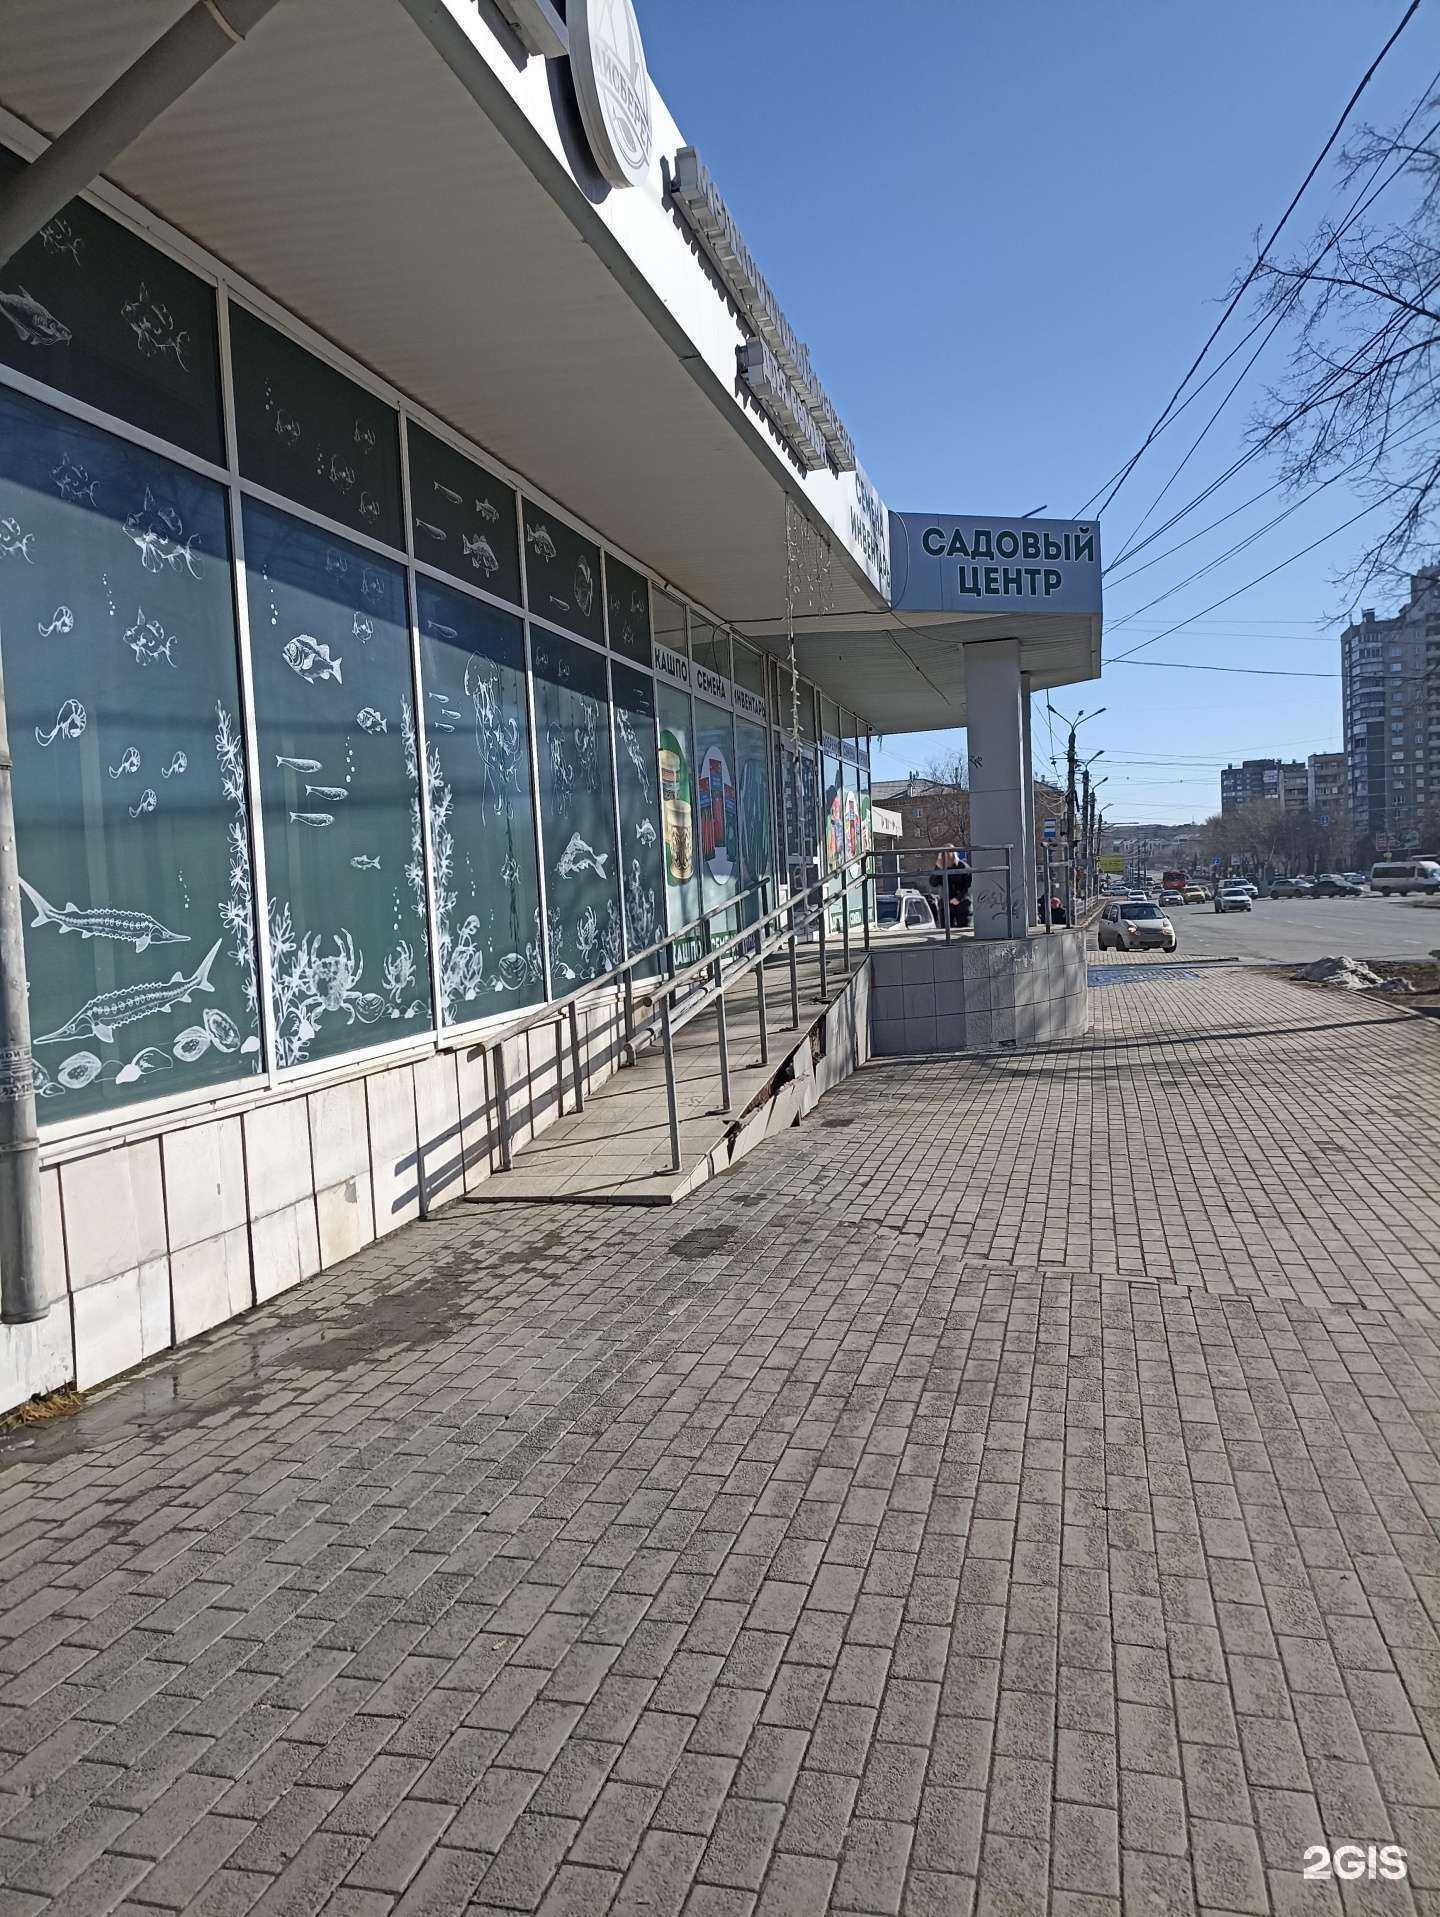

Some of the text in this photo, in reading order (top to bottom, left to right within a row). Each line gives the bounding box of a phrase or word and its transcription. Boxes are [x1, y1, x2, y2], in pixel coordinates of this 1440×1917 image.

[921, 526, 1096, 563] САДОВЫЙ
[957, 564, 1063, 598] ЦЕНТР
[655, 646, 688, 682] КАШПО
[697, 669, 726, 699] СЕМЕНА
